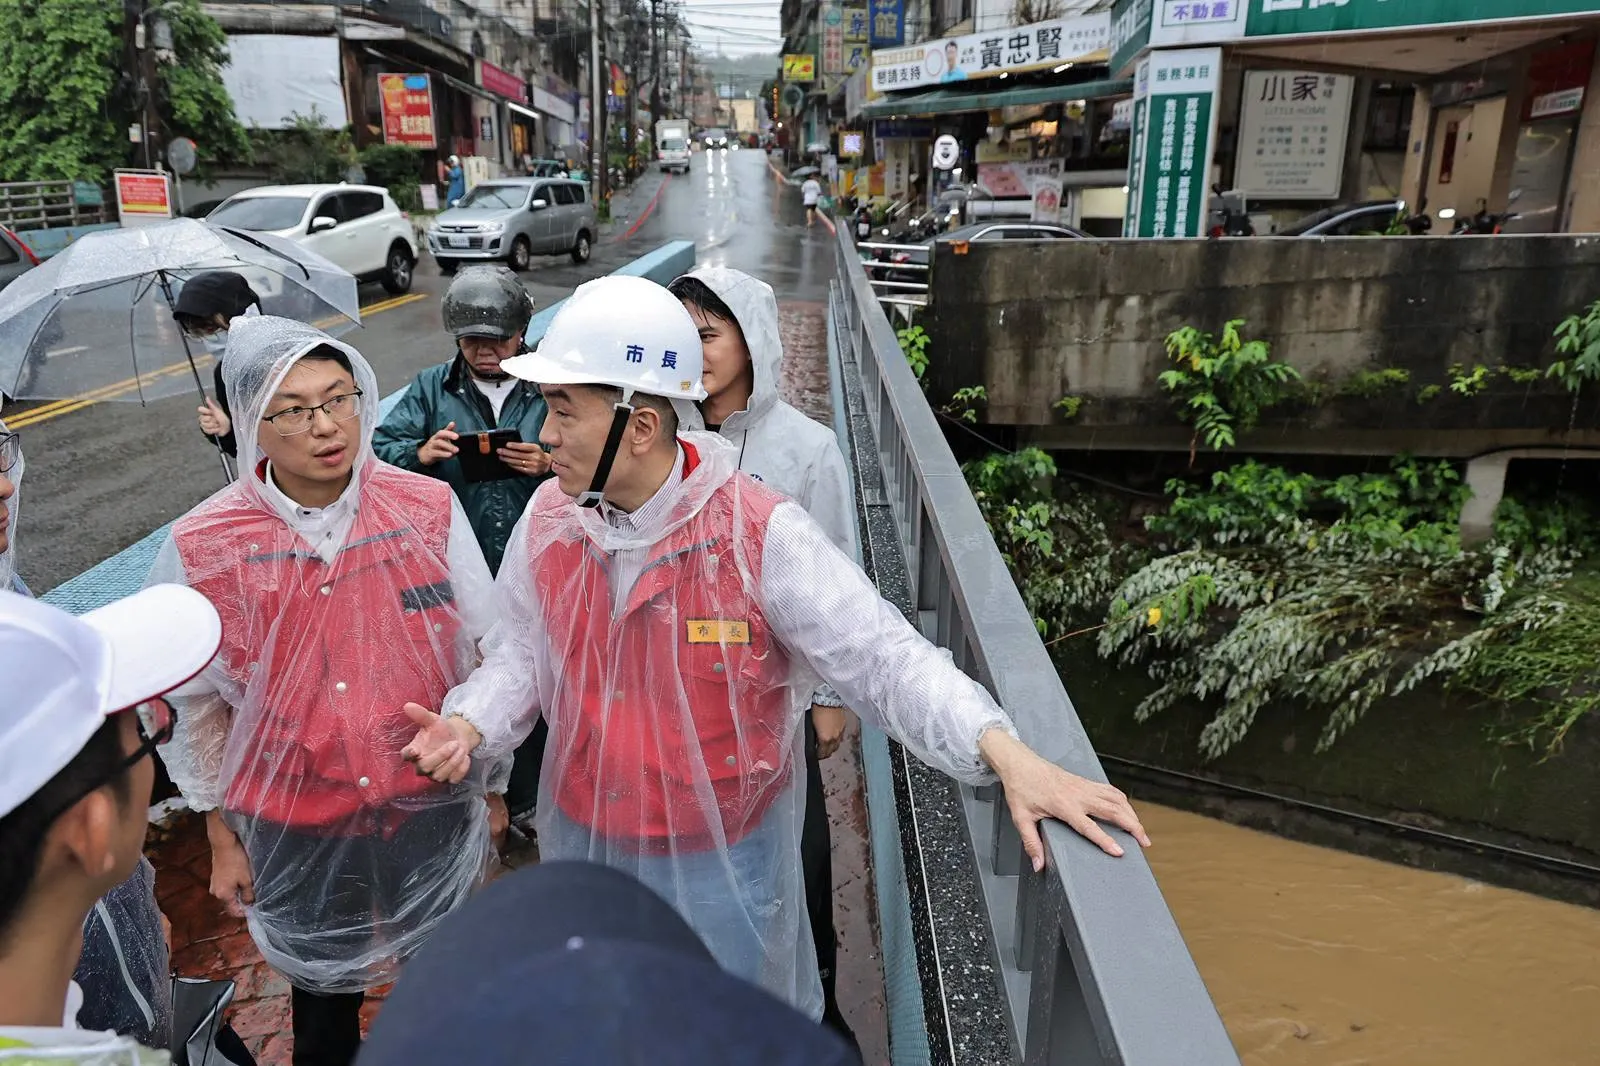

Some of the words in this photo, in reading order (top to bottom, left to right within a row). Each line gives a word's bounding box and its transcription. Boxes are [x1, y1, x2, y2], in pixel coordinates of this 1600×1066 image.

[1173, 1, 1230, 21] 不動產
[980, 27, 1062, 69] 黃忠賢
[877, 65, 921, 85] 懇請支持
[1156, 65, 1210, 82] 服務項目
[1260, 75, 1319, 102] 小家
[626, 344, 678, 370] 市長
[697, 624, 742, 638] 市長
